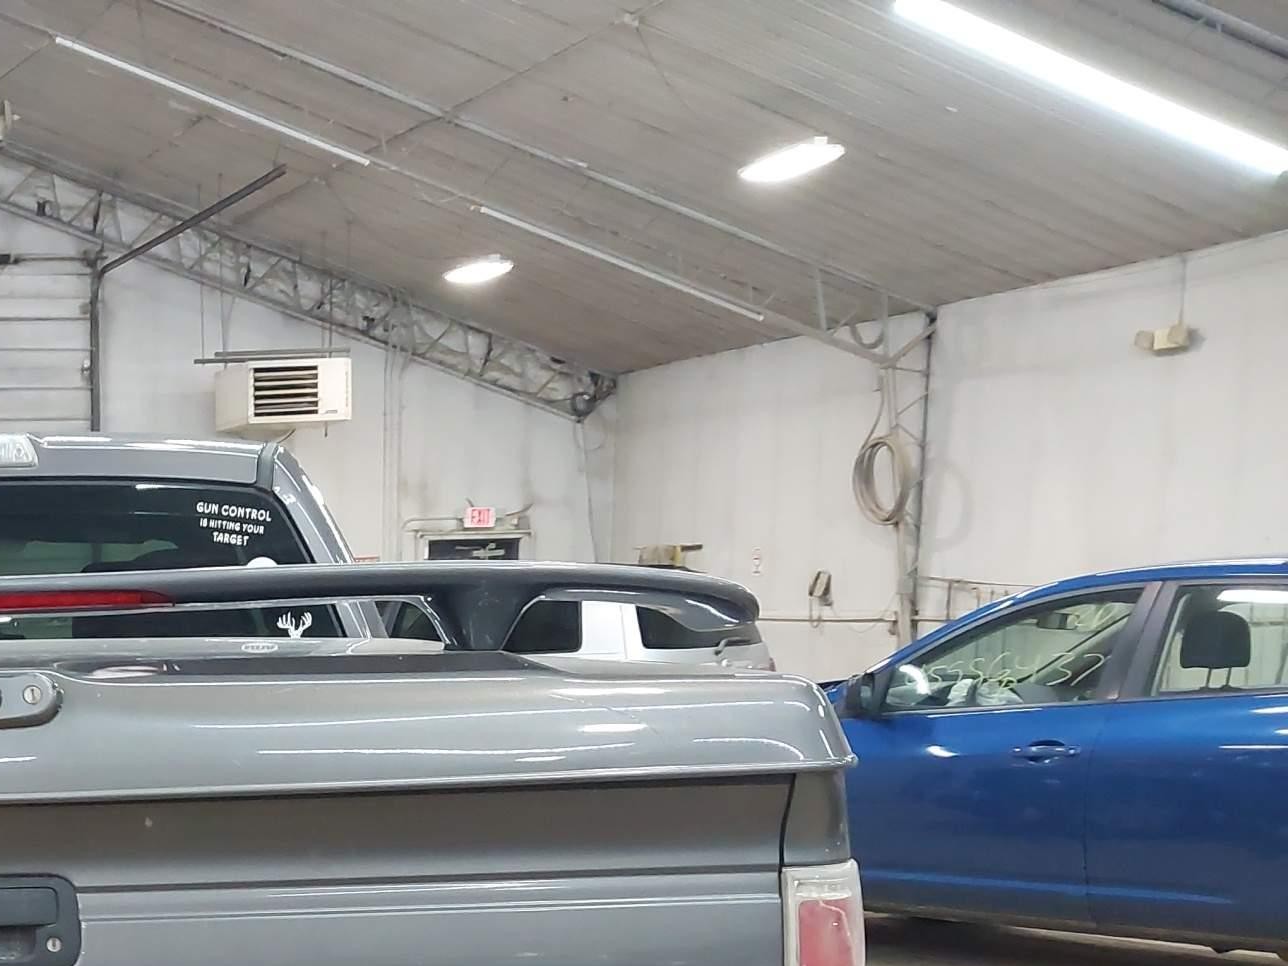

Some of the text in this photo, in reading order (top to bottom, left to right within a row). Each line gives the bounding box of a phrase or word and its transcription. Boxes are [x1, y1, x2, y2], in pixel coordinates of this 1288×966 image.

[196, 501, 272, 522] GUN CONTROL
[471, 508, 489, 524] EXIT
[200, 518, 264, 534] IS HITTING YOUR
[212, 531, 249, 546] TARGET
